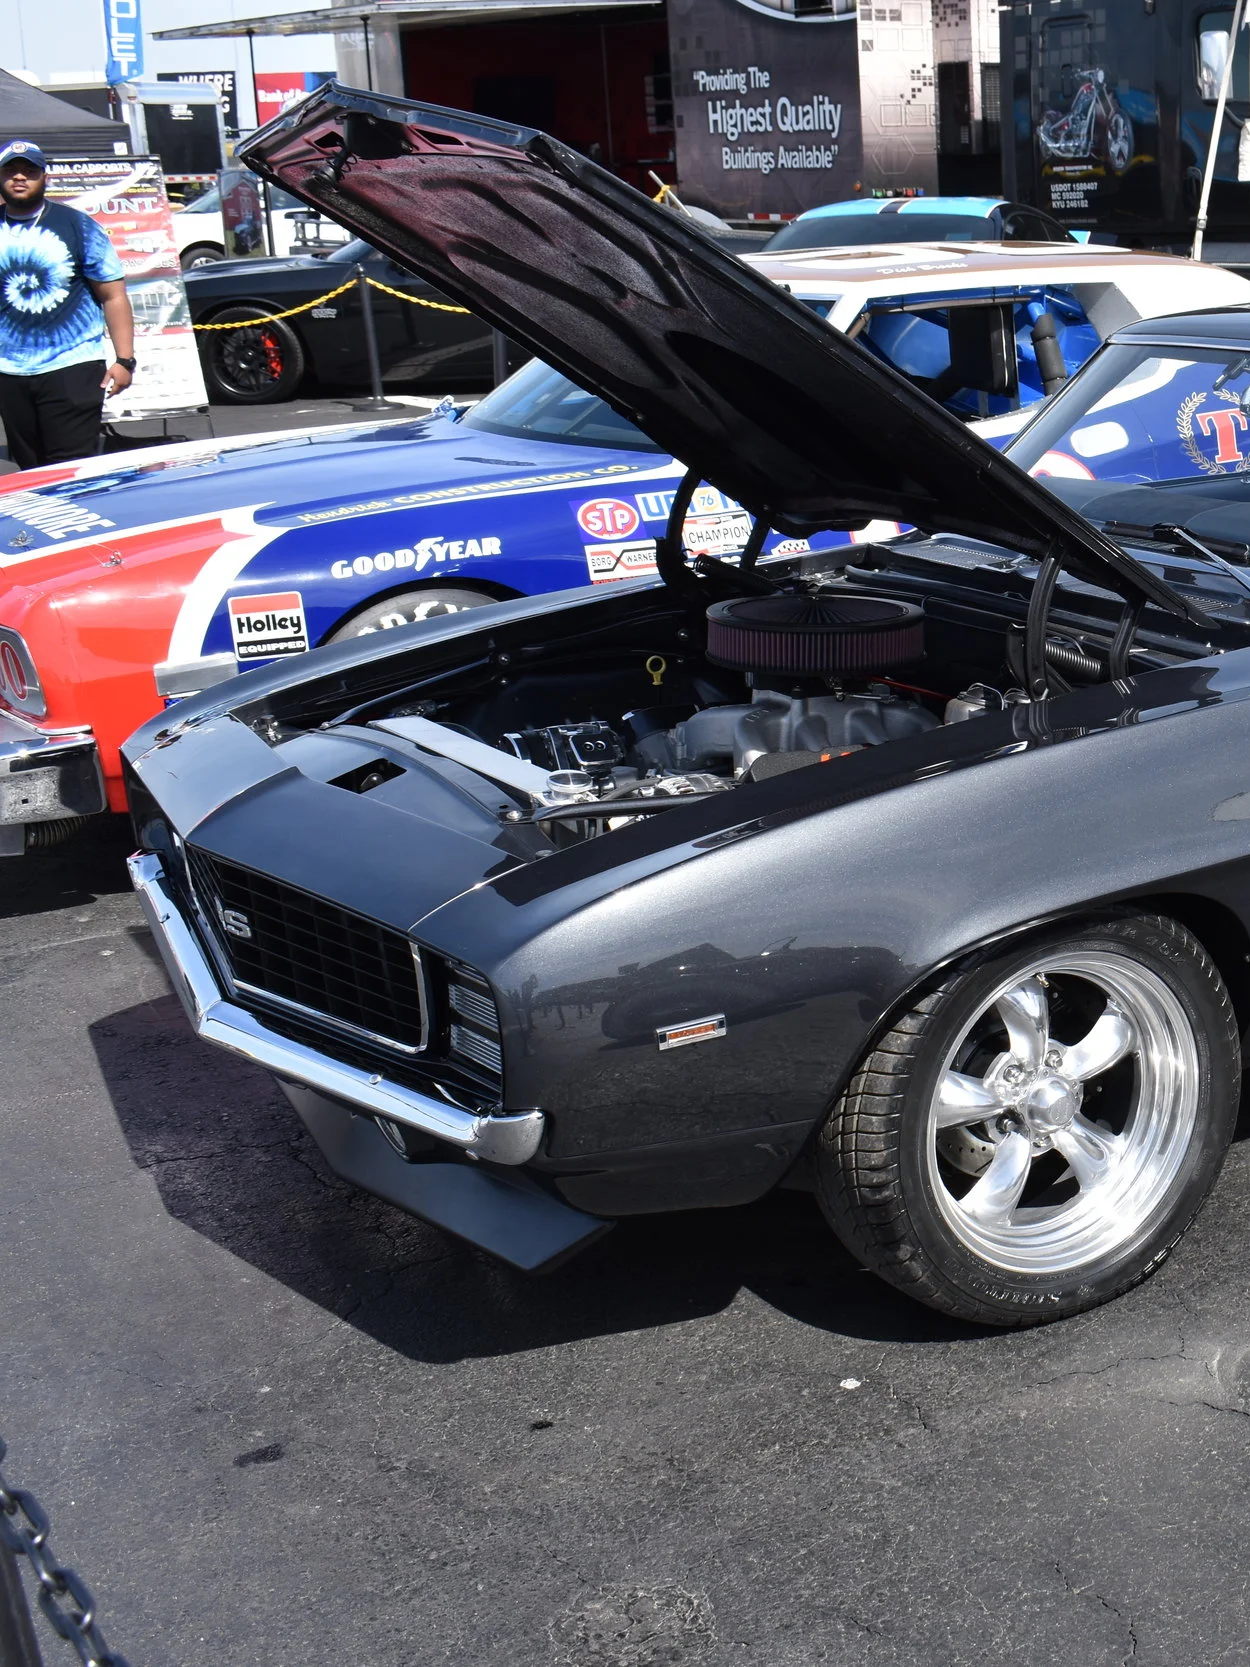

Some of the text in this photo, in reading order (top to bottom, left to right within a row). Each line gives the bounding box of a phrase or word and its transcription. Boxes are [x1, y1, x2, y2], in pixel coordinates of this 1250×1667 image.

[748, 67, 770, 89] The
[708, 95, 842, 141] Highest Quality
[722, 147, 775, 174] Buildings
[1051, 183, 1071, 191] USDOT
[1051, 192, 1061, 200] MC
[1195, 408, 1248, 463] T
[297, 464, 639, 523] Hendrick CONSTRUCTION CO.
[700, 494, 714, 506] 76
[586, 503, 630, 532] STP
[688, 525, 750, 544] CHAMPION
[331, 536, 501, 579] GOODYEAR
[591, 556, 612, 567] BORG
[237, 614, 302, 634] Holley
[239, 640, 306, 654] EQUIPPED
